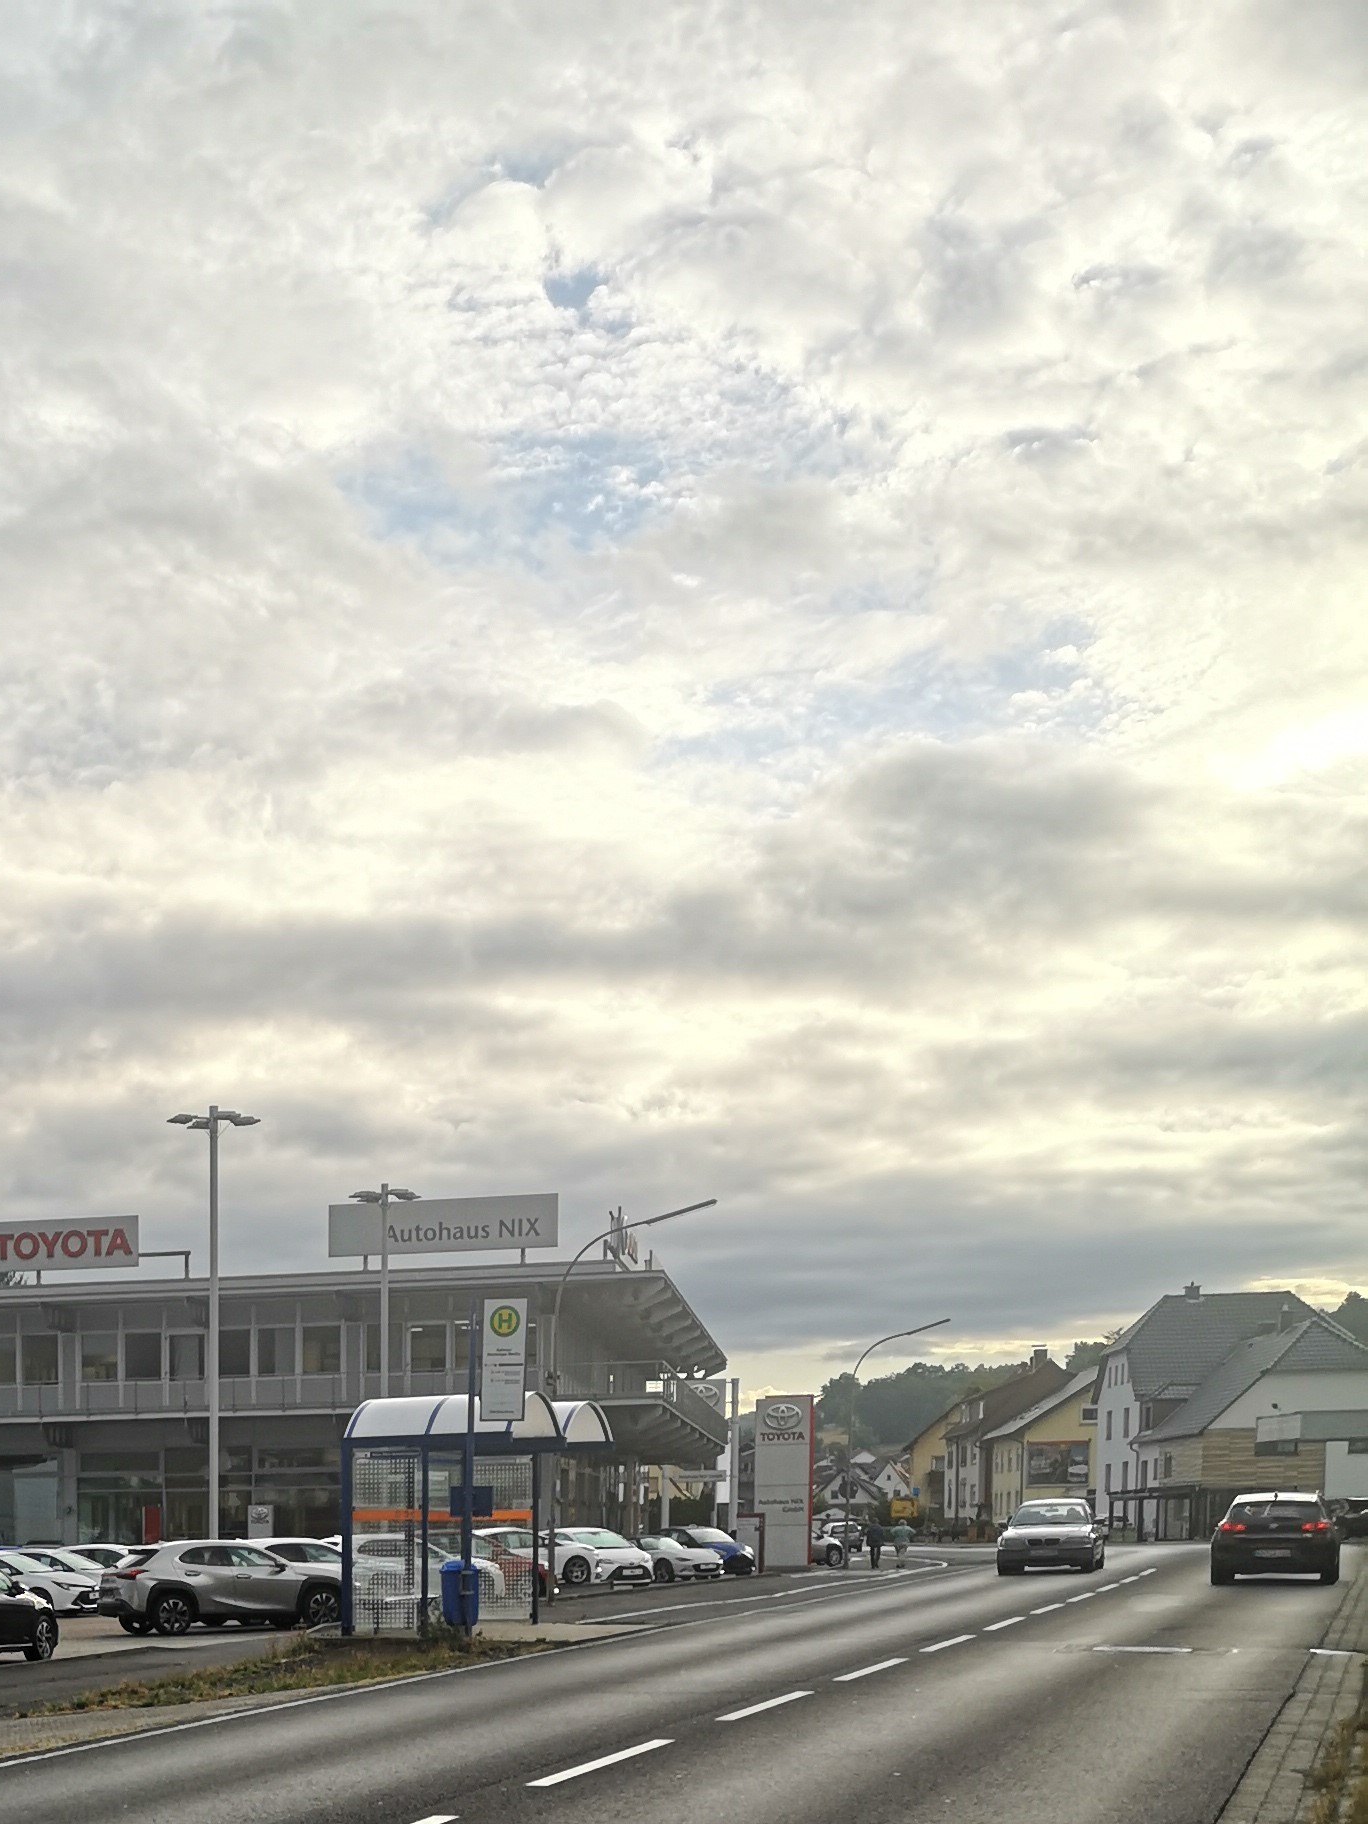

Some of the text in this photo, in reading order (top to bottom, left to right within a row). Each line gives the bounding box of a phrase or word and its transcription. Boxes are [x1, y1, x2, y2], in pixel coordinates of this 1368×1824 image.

[387, 1217, 541, 1243] Autohaus NIX
[498, 1313, 513, 1330] H
[760, 1432, 805, 1441] TOYOTA
